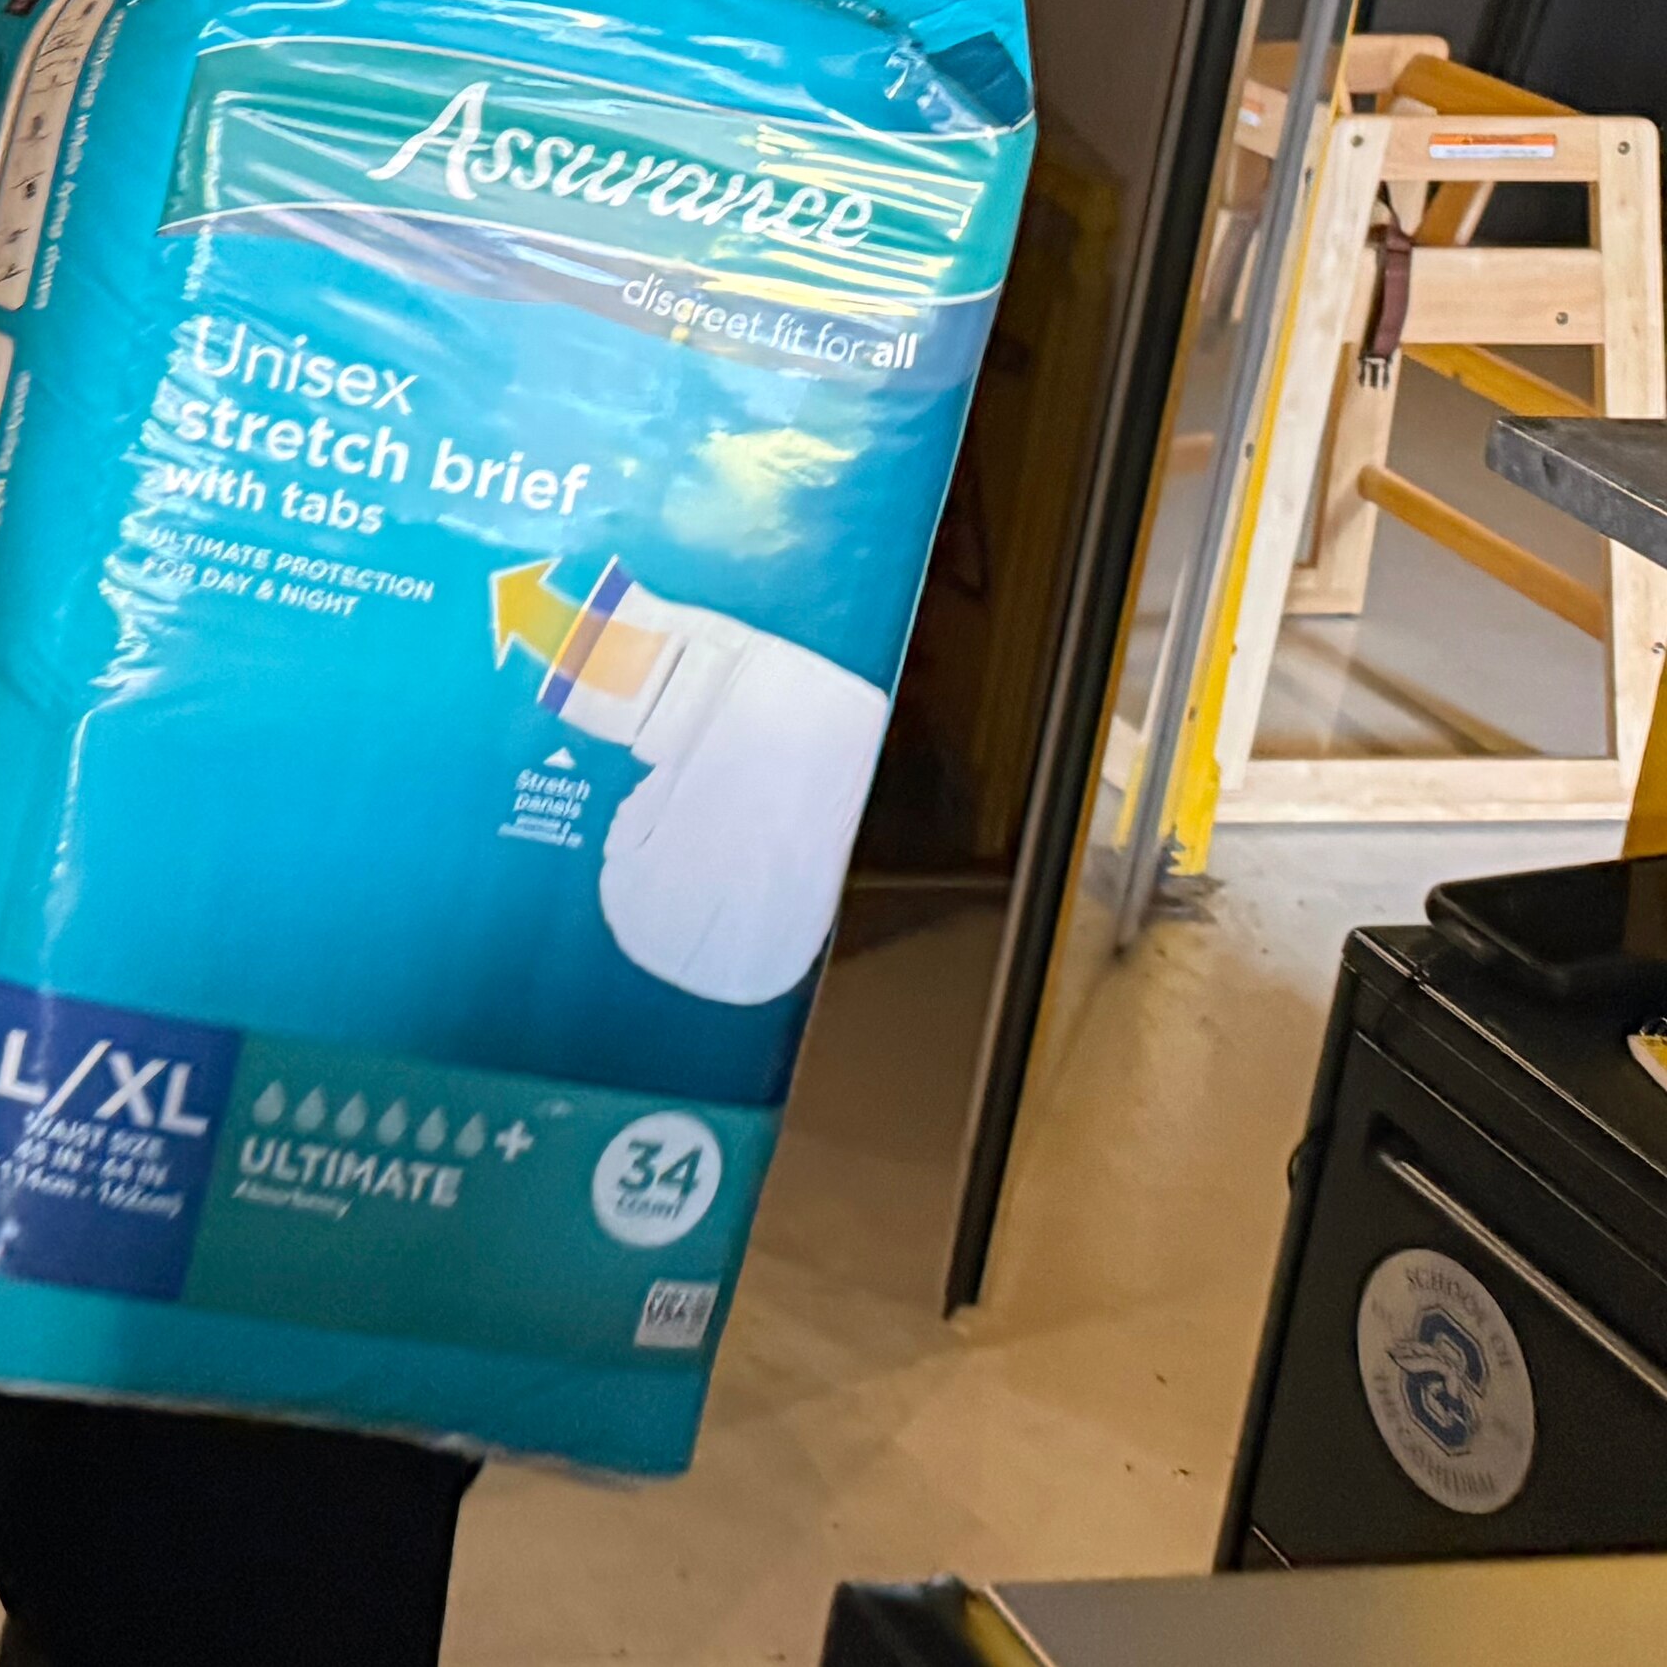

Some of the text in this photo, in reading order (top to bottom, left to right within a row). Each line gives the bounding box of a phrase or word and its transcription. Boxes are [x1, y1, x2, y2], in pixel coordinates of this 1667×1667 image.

[368, 81, 873, 247] Assurance
[622, 273, 919, 369] discreet fit for all
[192, 316, 420, 416] Unisex
[176, 398, 592, 517] stretch brief
[162, 463, 387, 535] with tabs
[141, 557, 362, 617] FOR DAY & NIGHT
[147, 527, 435, 603] ULTIMATE PROTECTION
[240, 1135, 464, 1209] ULTIMATE
[618, 1139, 704, 1210] 34
